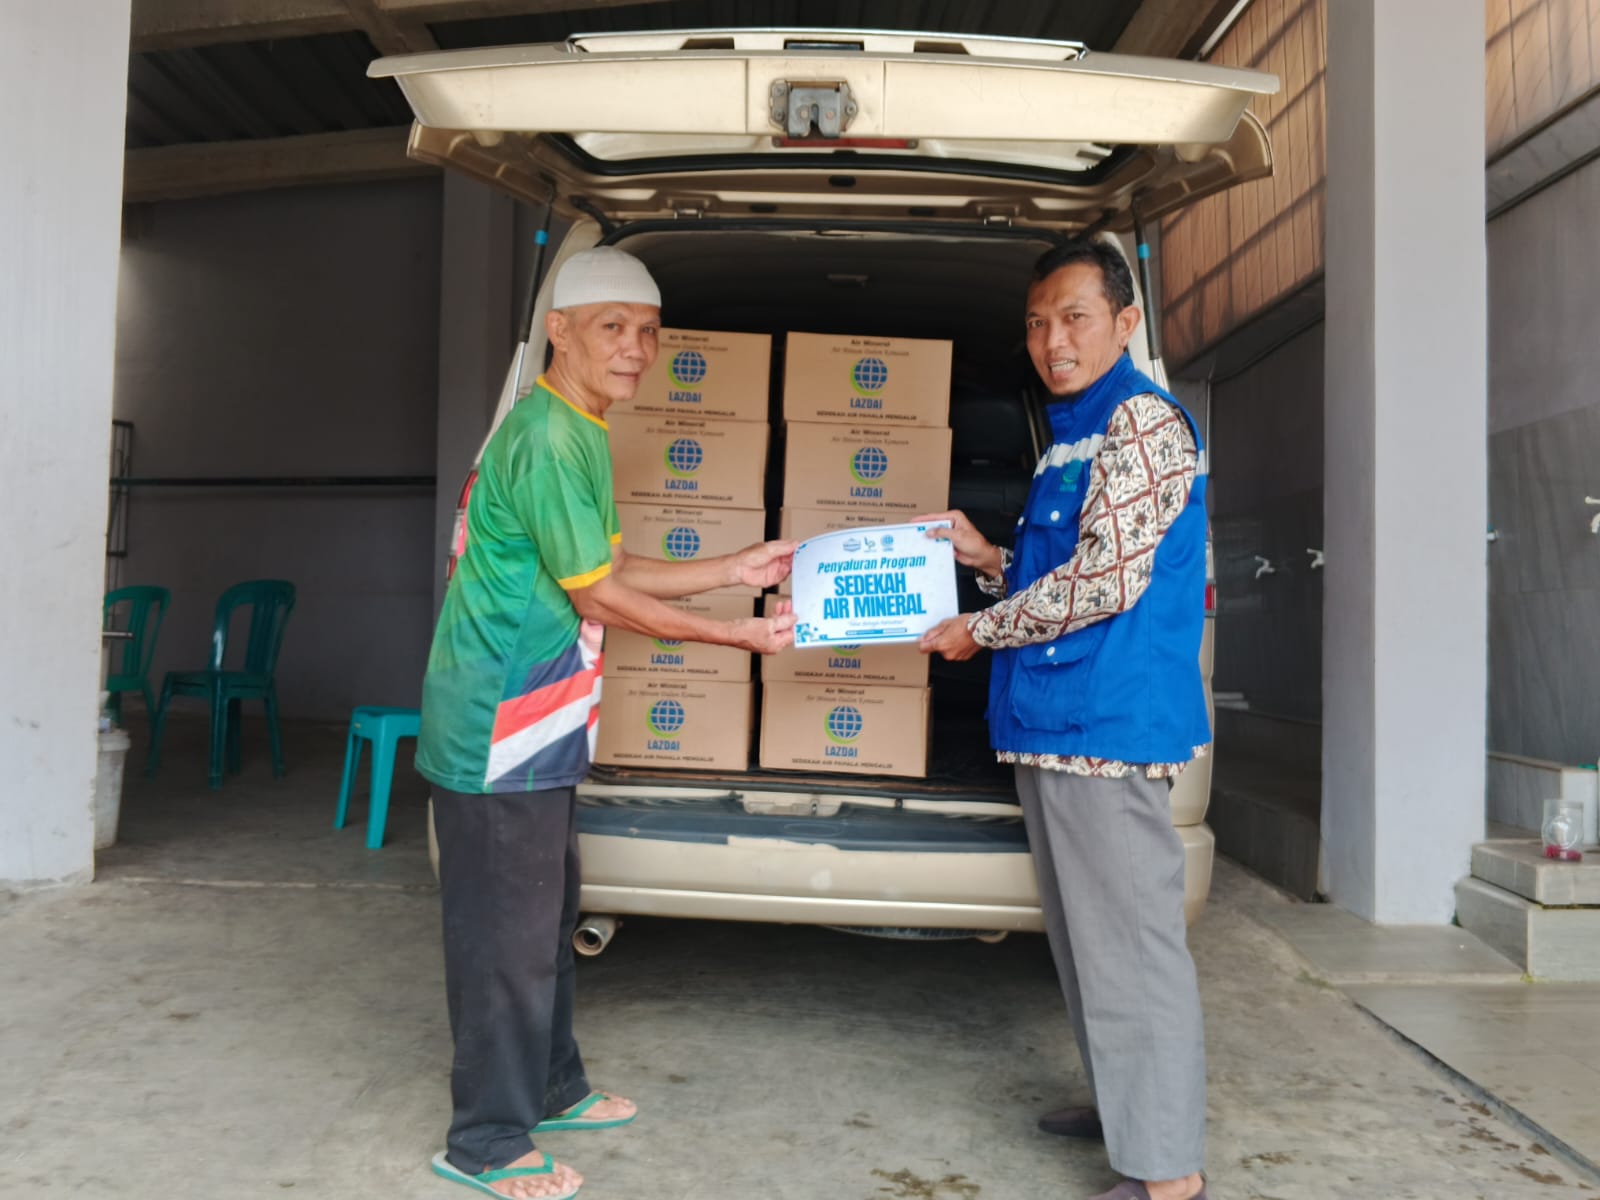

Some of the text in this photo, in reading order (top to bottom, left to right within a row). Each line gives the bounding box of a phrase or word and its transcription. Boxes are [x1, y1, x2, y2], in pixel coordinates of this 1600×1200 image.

[668, 391, 702, 402] LAZDAI
[850, 398, 882, 409] LAZDAI
[665, 479, 698, 491] LAZDAI
[850, 486, 882, 498] LAZDAI
[817, 555, 926, 574] Penyaluran Program
[834, 572, 906, 596] SEDEKAH
[823, 593, 927, 620] AIR MINERAL
[650, 653, 684, 665] LAZDAI
[828, 657, 861, 669] LAZDAI
[647, 740, 680, 751] LAZDAI
[825, 746, 858, 758] LAZDAI
